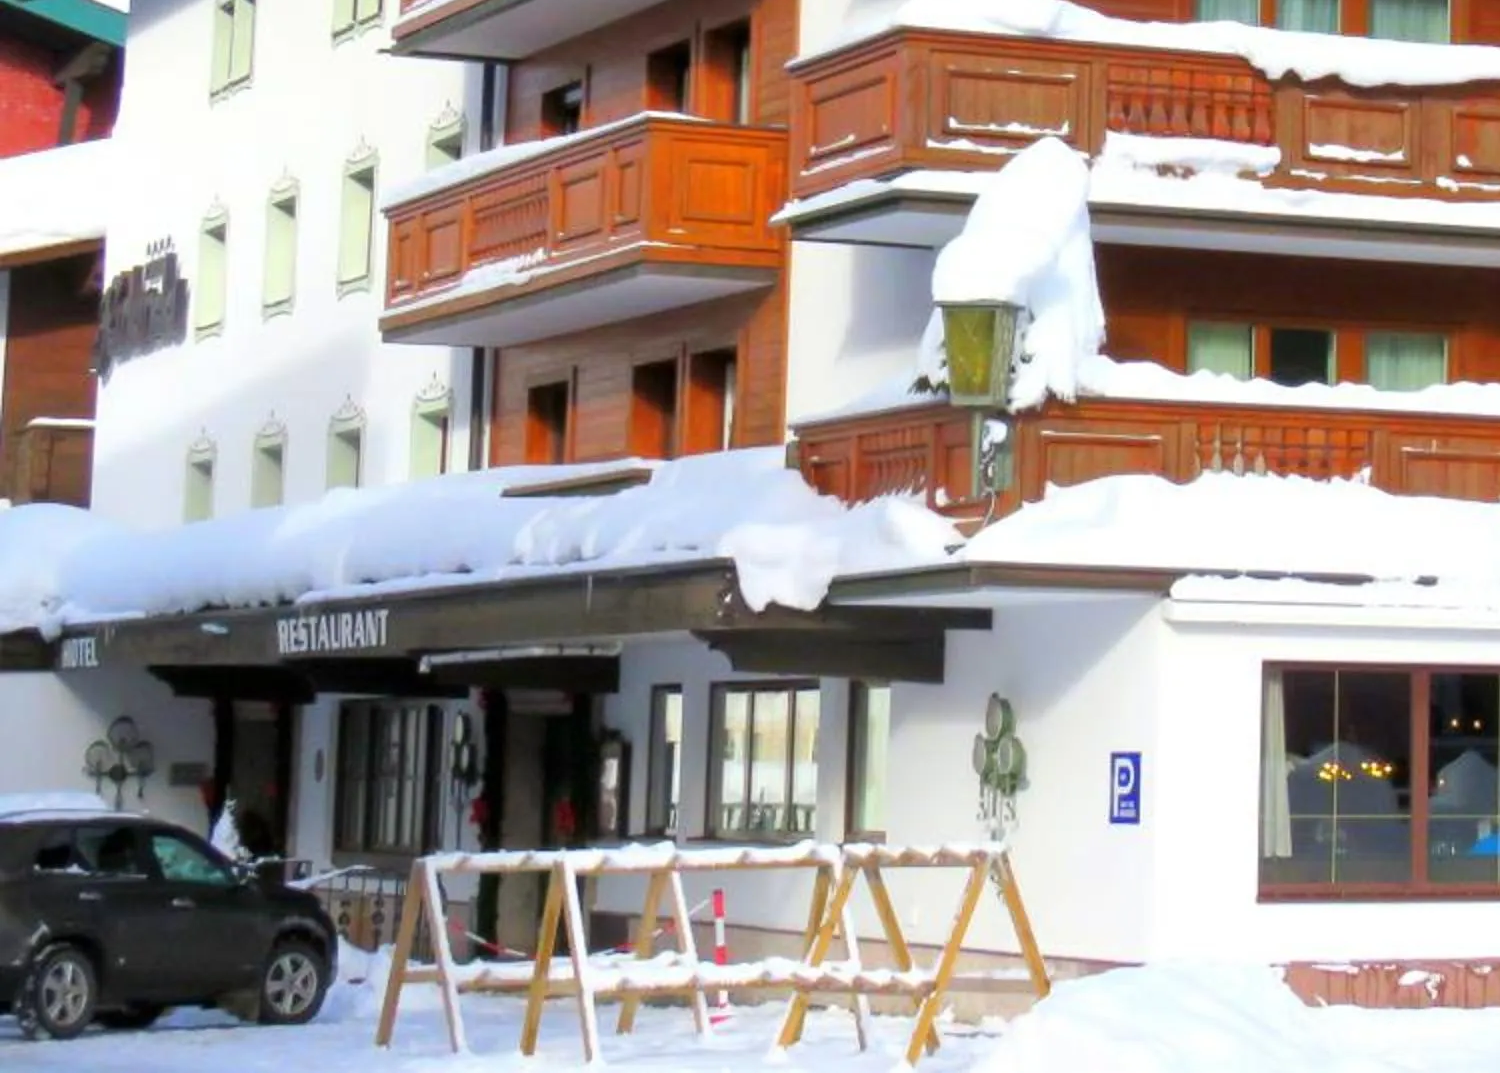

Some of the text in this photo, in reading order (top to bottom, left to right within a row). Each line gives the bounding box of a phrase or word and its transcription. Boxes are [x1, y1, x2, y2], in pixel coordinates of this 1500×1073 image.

[61, 637, 99, 668] HOTEL
[277, 609, 390, 654] RESTAURANT
[1113, 757, 1135, 818] P
